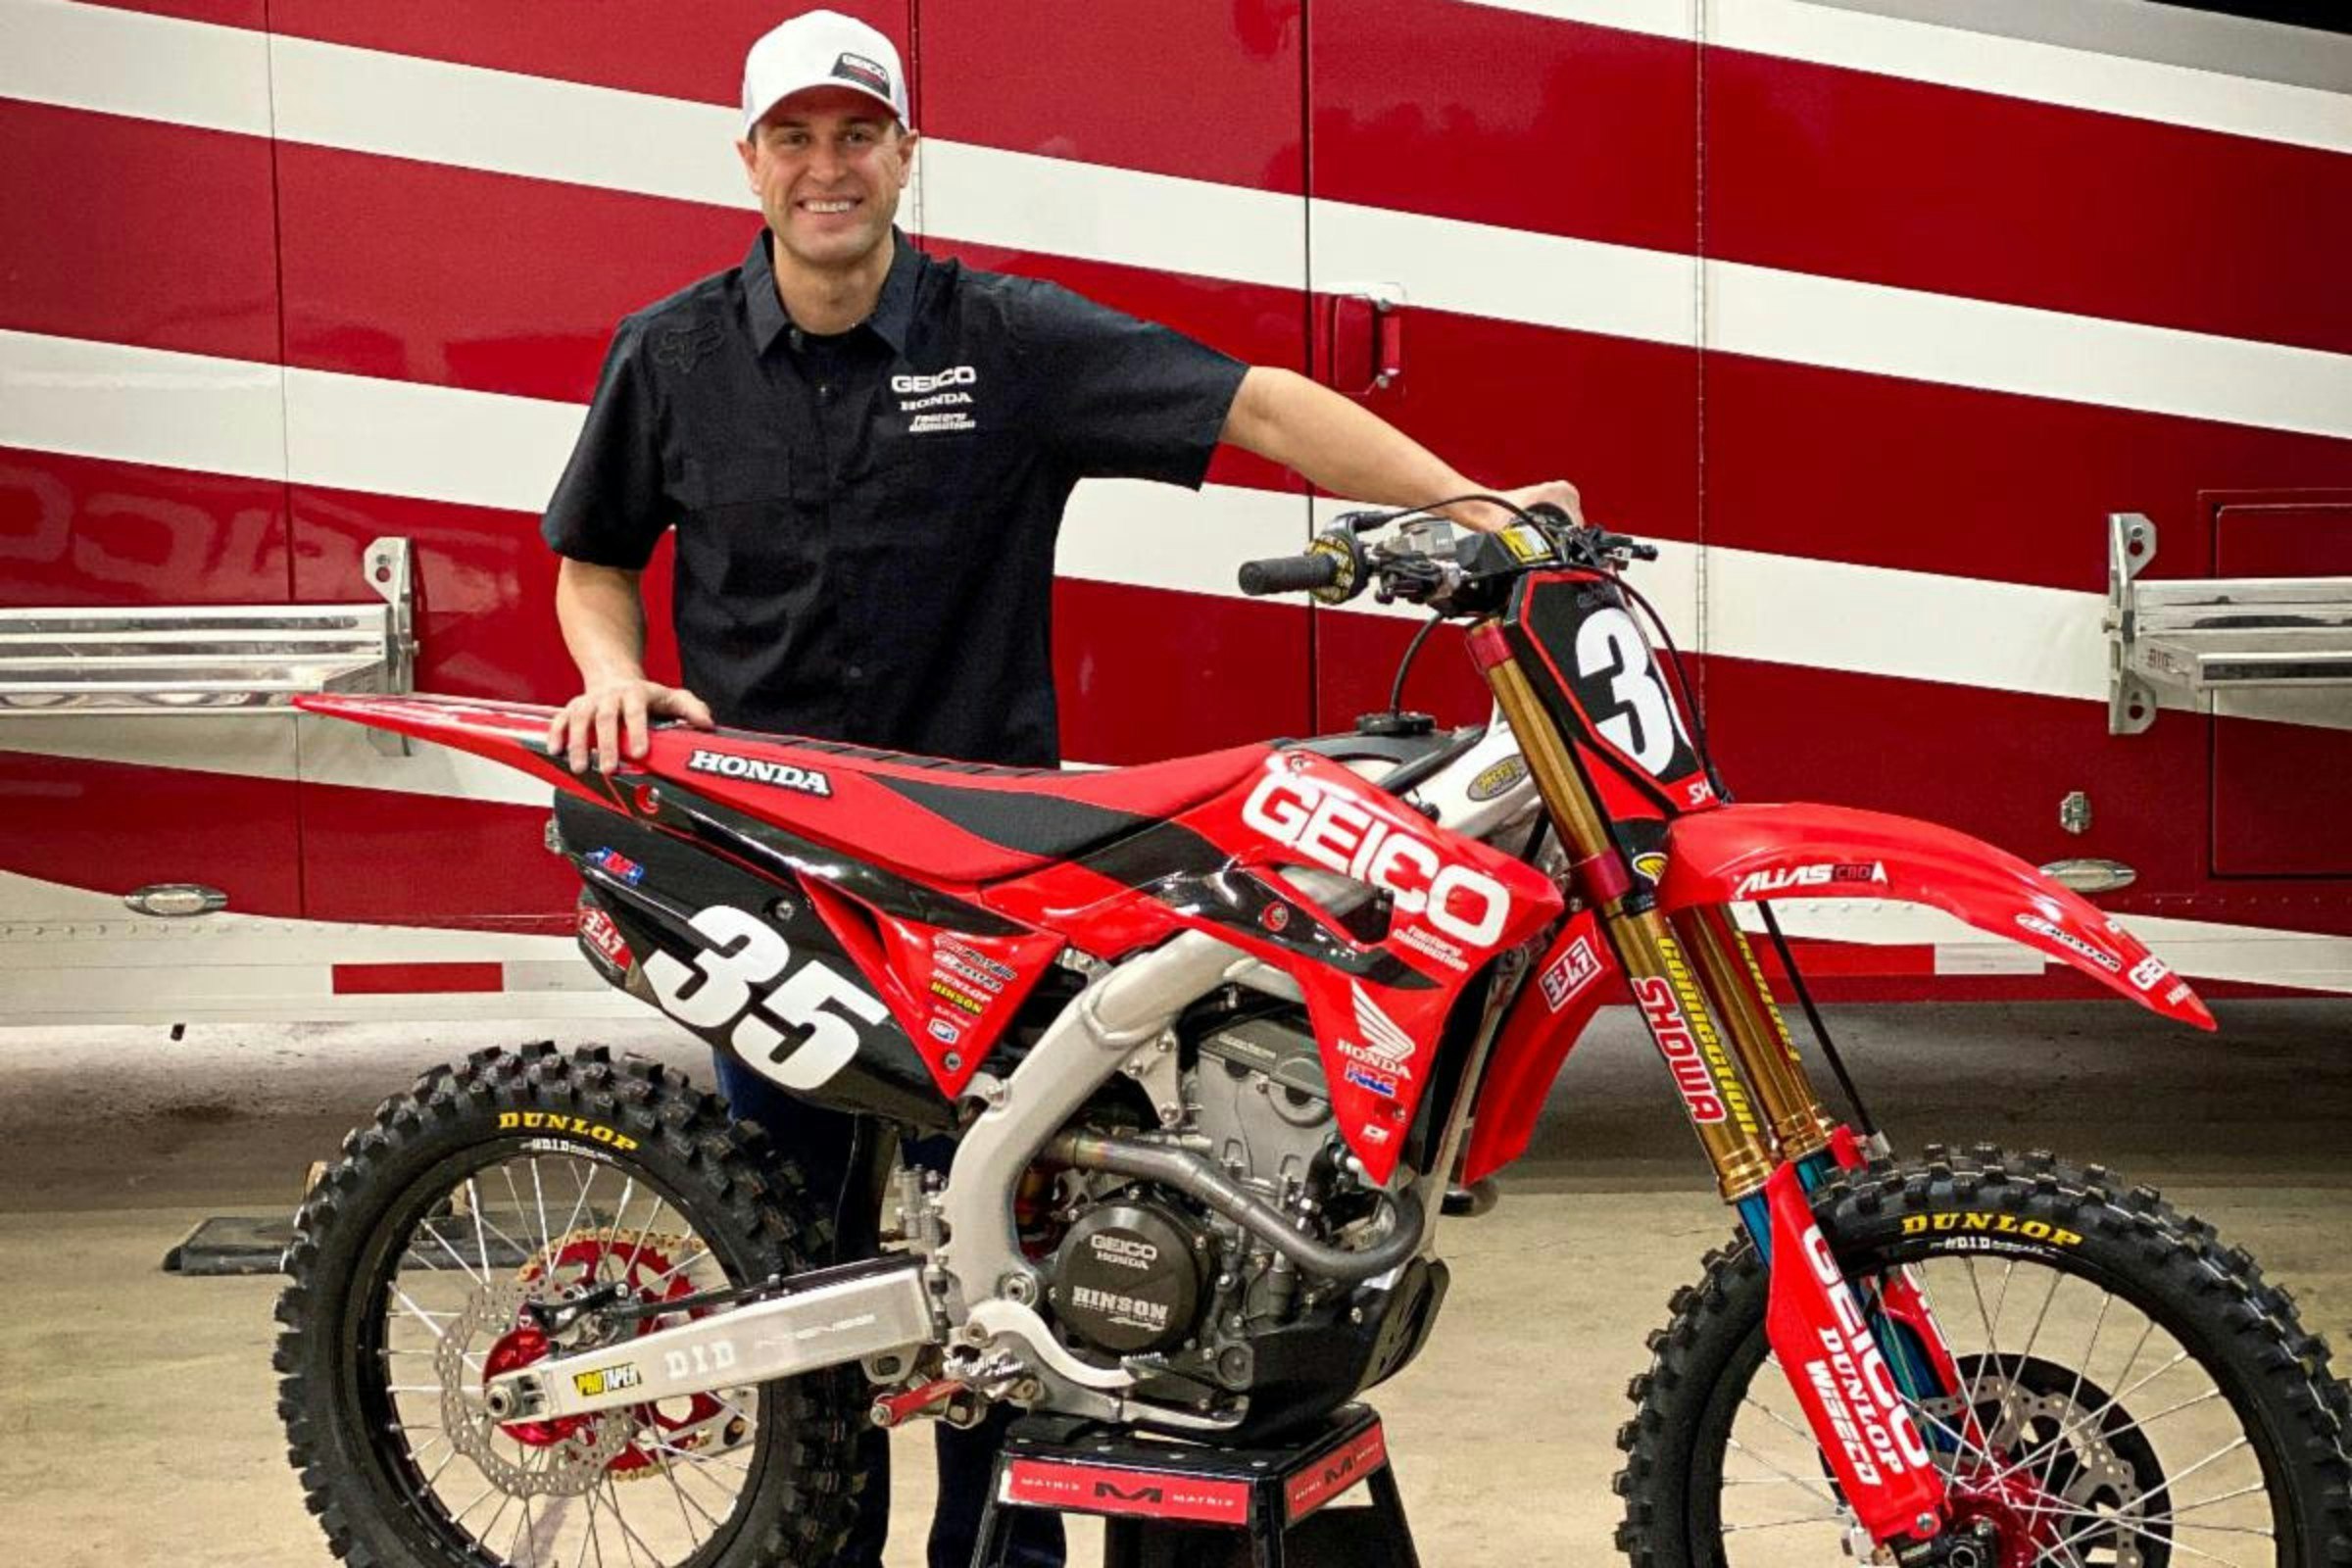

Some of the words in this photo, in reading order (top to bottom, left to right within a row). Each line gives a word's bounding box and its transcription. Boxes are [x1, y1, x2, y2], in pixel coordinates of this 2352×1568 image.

[891, 366, 977, 393] GEICO
[900, 392, 973, 411] HONDA
[689, 750, 831, 796] HONDA
[1242, 770, 1511, 949] GEICO
[642, 905, 890, 1091] 35
[931, 981, 983, 1016] HINSON
[932, 968, 992, 1002] DUNLOP
[1337, 1038, 1412, 1080] HONDA
[1631, 975, 1728, 1124] SHOWA
[500, 1111, 638, 1152] DUNLOP
[1900, 1211, 2083, 1247] DUNLOP
[1091, 1234, 1157, 1261] GEICO
[1097, 1250, 1150, 1270] HONDA
[1072, 1285, 1169, 1320] HINSON
[1818, 1326, 1905, 1474] DUNLOP
